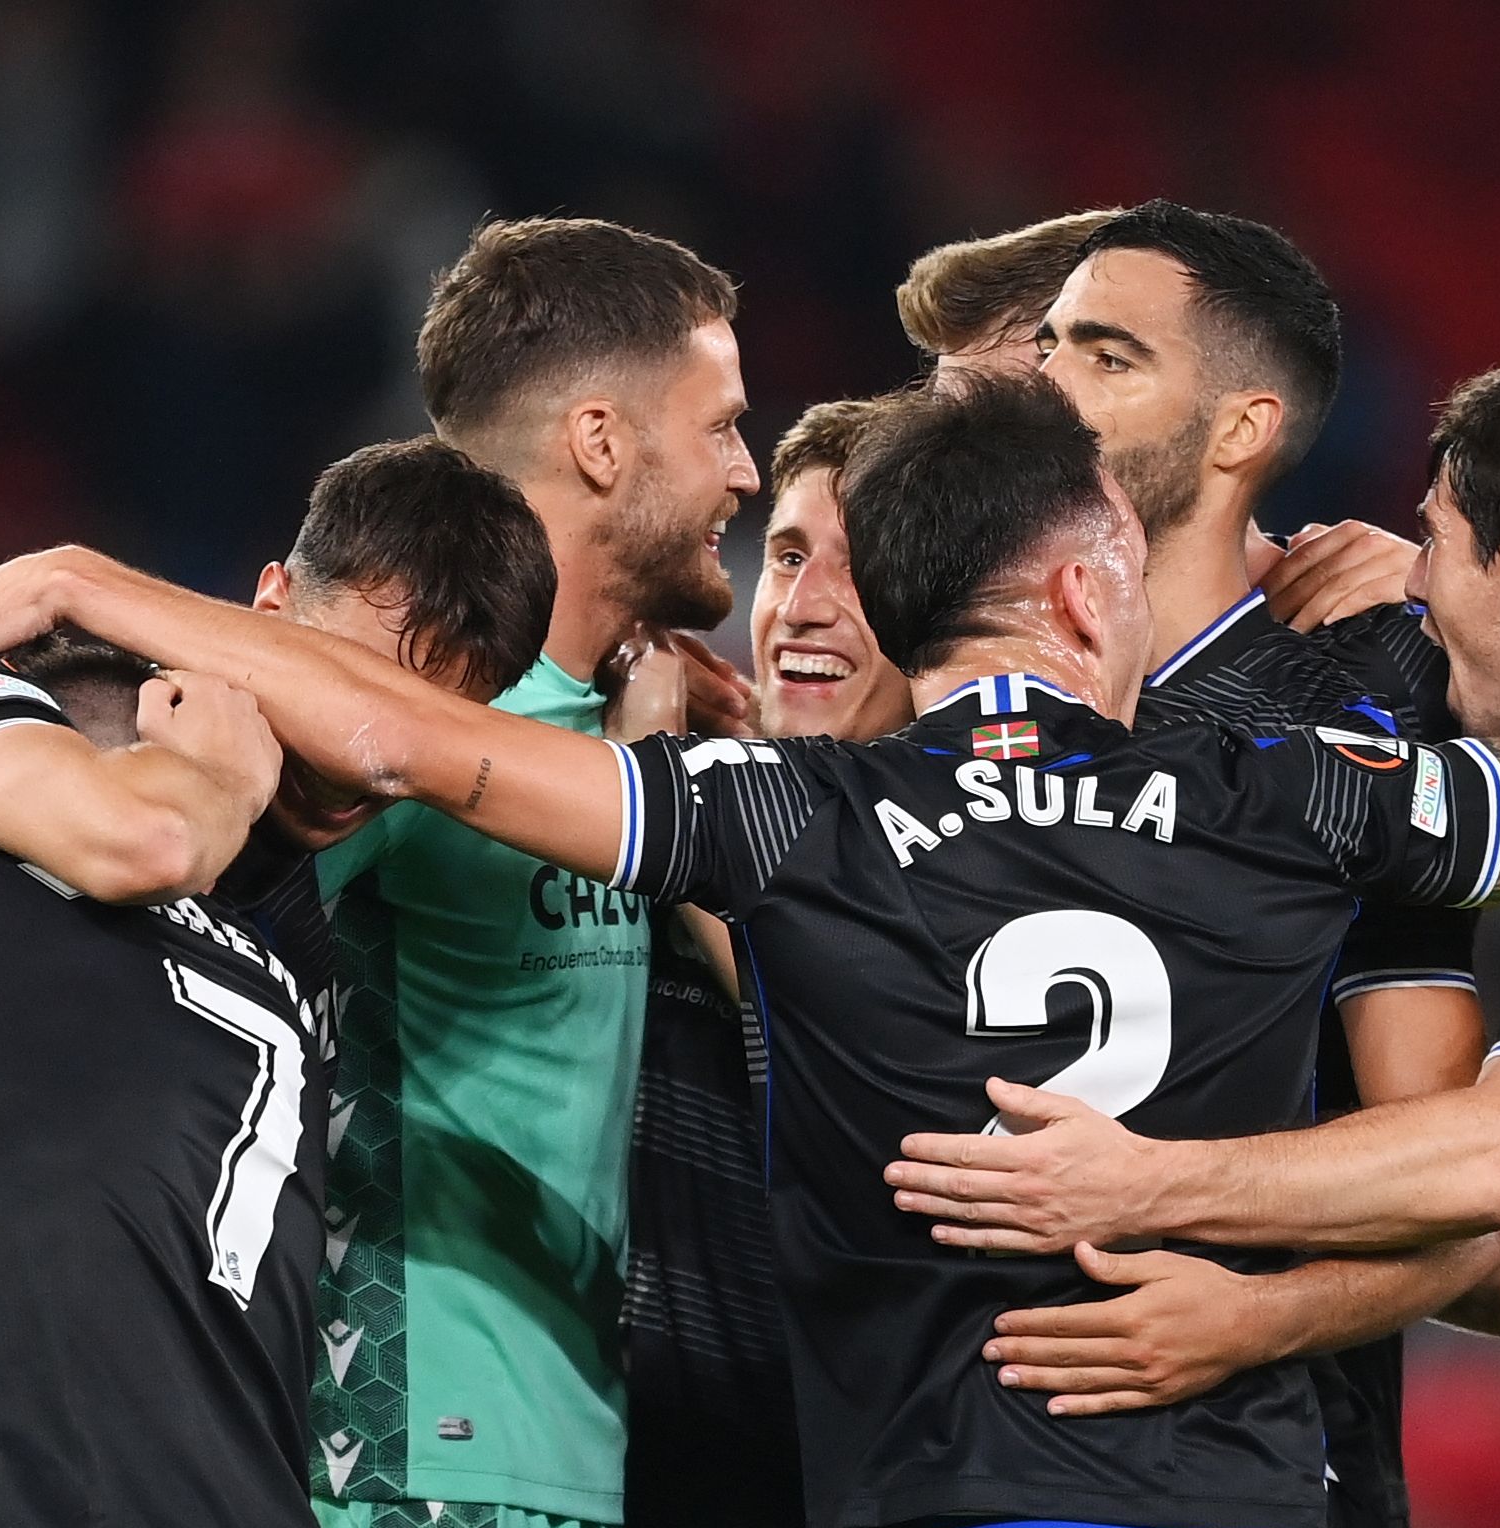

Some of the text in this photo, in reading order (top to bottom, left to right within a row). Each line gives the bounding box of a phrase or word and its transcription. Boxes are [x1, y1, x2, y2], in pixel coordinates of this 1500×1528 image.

[1418, 751, 1441, 828] FOUNDA
[162, 957, 306, 1312] 7
[964, 909, 1172, 1137] 2
